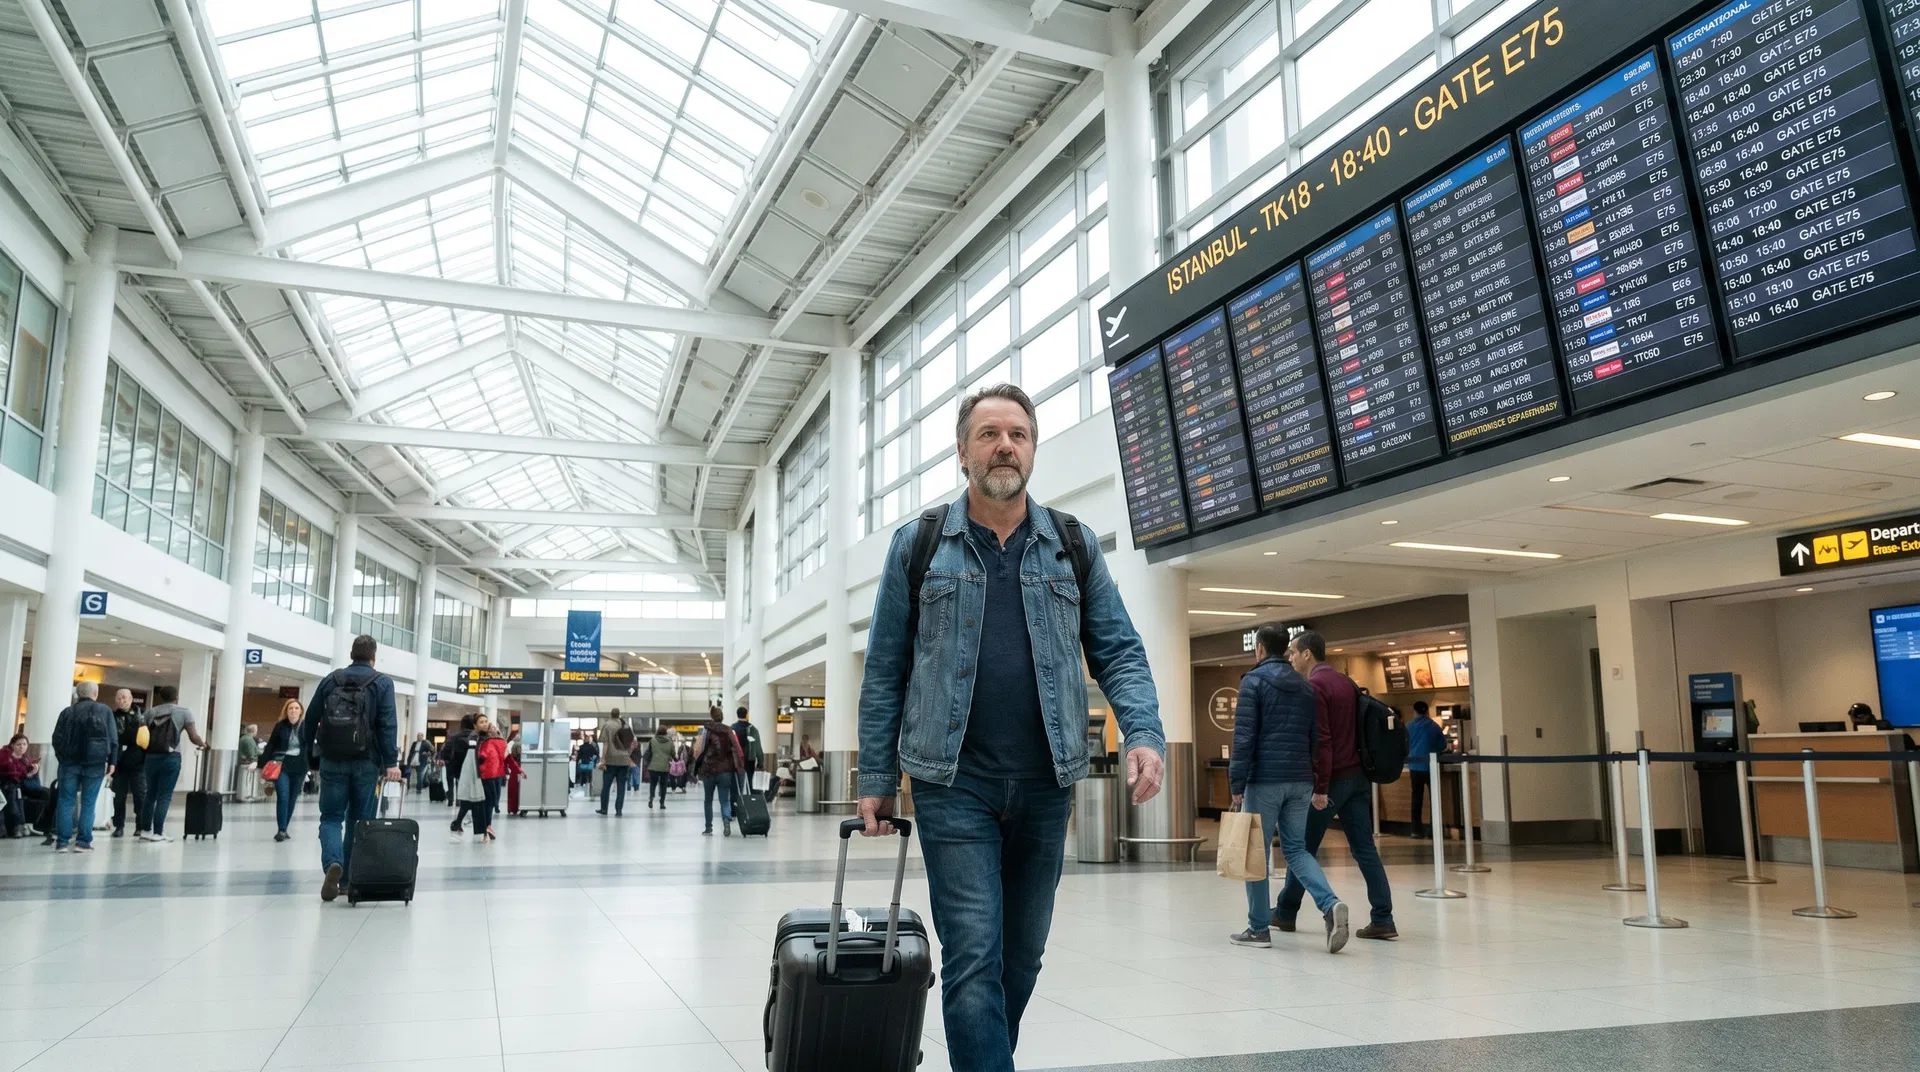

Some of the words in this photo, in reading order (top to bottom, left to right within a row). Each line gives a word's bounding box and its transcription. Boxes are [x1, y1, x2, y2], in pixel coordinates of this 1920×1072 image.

[1715, 46, 1741, 66] 17:30
[1790, 5, 1812, 25] E75
[1795, 25, 1817, 44] E75
[1764, 59, 1796, 82] GATE
[1799, 45, 1821, 64] E75
[1768, 78, 1800, 101] GATE
[1803, 65, 1826, 84] E75
[1772, 98, 1805, 121] GATE
[1808, 85, 1831, 104] E75
[1638, 115, 1656, 130] E75
[1777, 118, 1810, 140] GATE
[1813, 105, 1836, 124] E75
[1167, 226, 1247, 294] ISTANBUL
[1260, 181, 1311, 231] TK18
[1330, 126, 1391, 186] 18:40
[1414, 55, 1494, 130] GATE
[1501, 6, 1563, 75] E75
[1642, 132, 1660, 148] E75
[1781, 138, 1814, 160] GATE
[1817, 126, 1840, 144] E75
[1646, 150, 1664, 166] E75
[1786, 158, 1819, 179] GATE
[1822, 146, 1845, 164] E75
[1649, 168, 1667, 183] E75
[1653, 185, 1671, 201] E75
[1748, 199, 1776, 217] 17:00
[1790, 178, 1824, 200] GATE
[1826, 167, 1850, 185] E75
[1657, 204, 1675, 219] E75
[1716, 235, 1743, 252] 14:40
[1795, 198, 1829, 219] GATE
[1832, 187, 1855, 205] E75
[1664, 239, 1683, 254] E75
[1720, 254, 1747, 271] 10:50
[1799, 219, 1833, 239] GATE
[1836, 208, 1860, 226] E75
[1761, 258, 1790, 275] 16:40
[1804, 239, 1838, 259] GATE
[1840, 229, 1864, 246] E75
[1668, 258, 1687, 273] E75
[1808, 259, 1842, 280] GATE
[1845, 250, 1869, 267] E75
[1676, 295, 1695, 309] E75
[1769, 298, 1798, 315] 16:40
[1812, 280, 1847, 300] GATE
[1679, 313, 1699, 328] E75
[1684, 332, 1703, 346] E75
[1870, 522, 1920, 541] Depart
